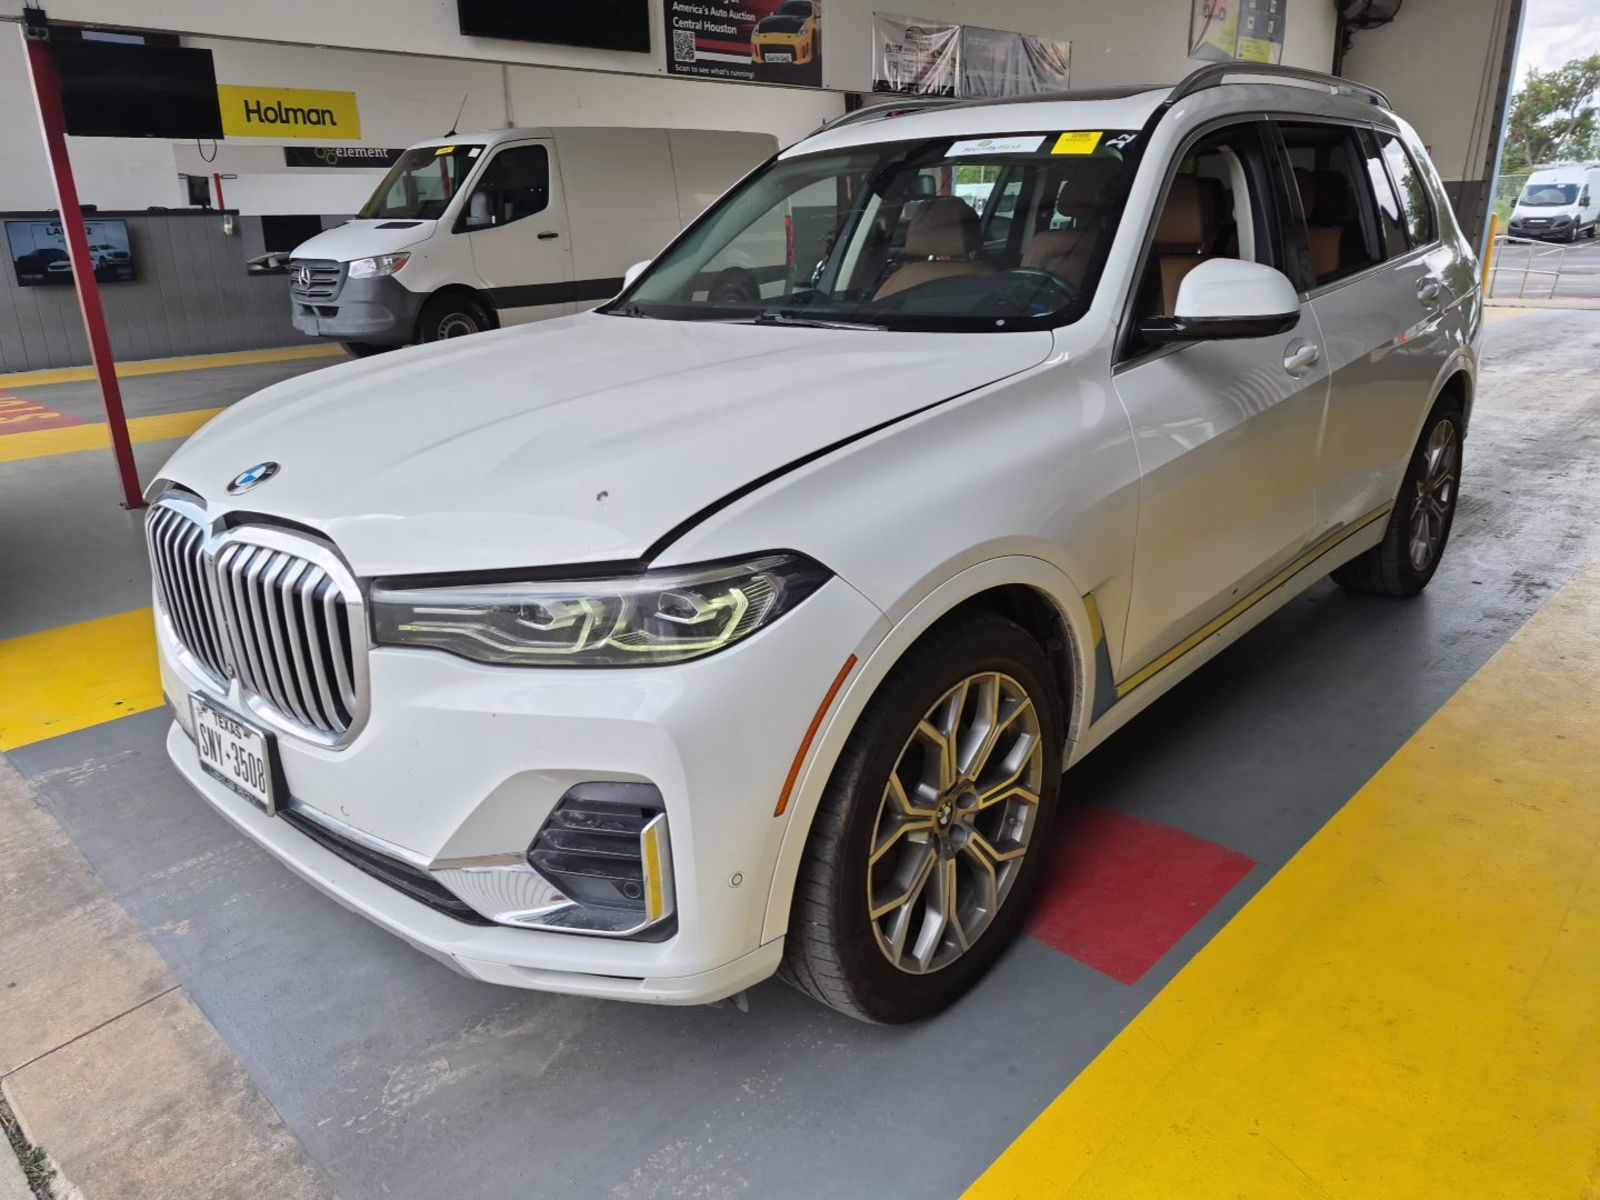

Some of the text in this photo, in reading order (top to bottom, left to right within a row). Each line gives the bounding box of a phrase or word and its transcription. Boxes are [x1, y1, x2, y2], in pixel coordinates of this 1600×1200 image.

[672, 1, 756, 22] America's Auto Auction
[673, 16, 737, 35] Central Houston
[674, 64, 690, 73] Scan
[711, 68, 729, 76] what's
[730, 70, 755, 80] running!
[243, 99, 337, 127] Holman
[335, 147, 389, 158] element
[212, 711, 242, 740] TEXAS
